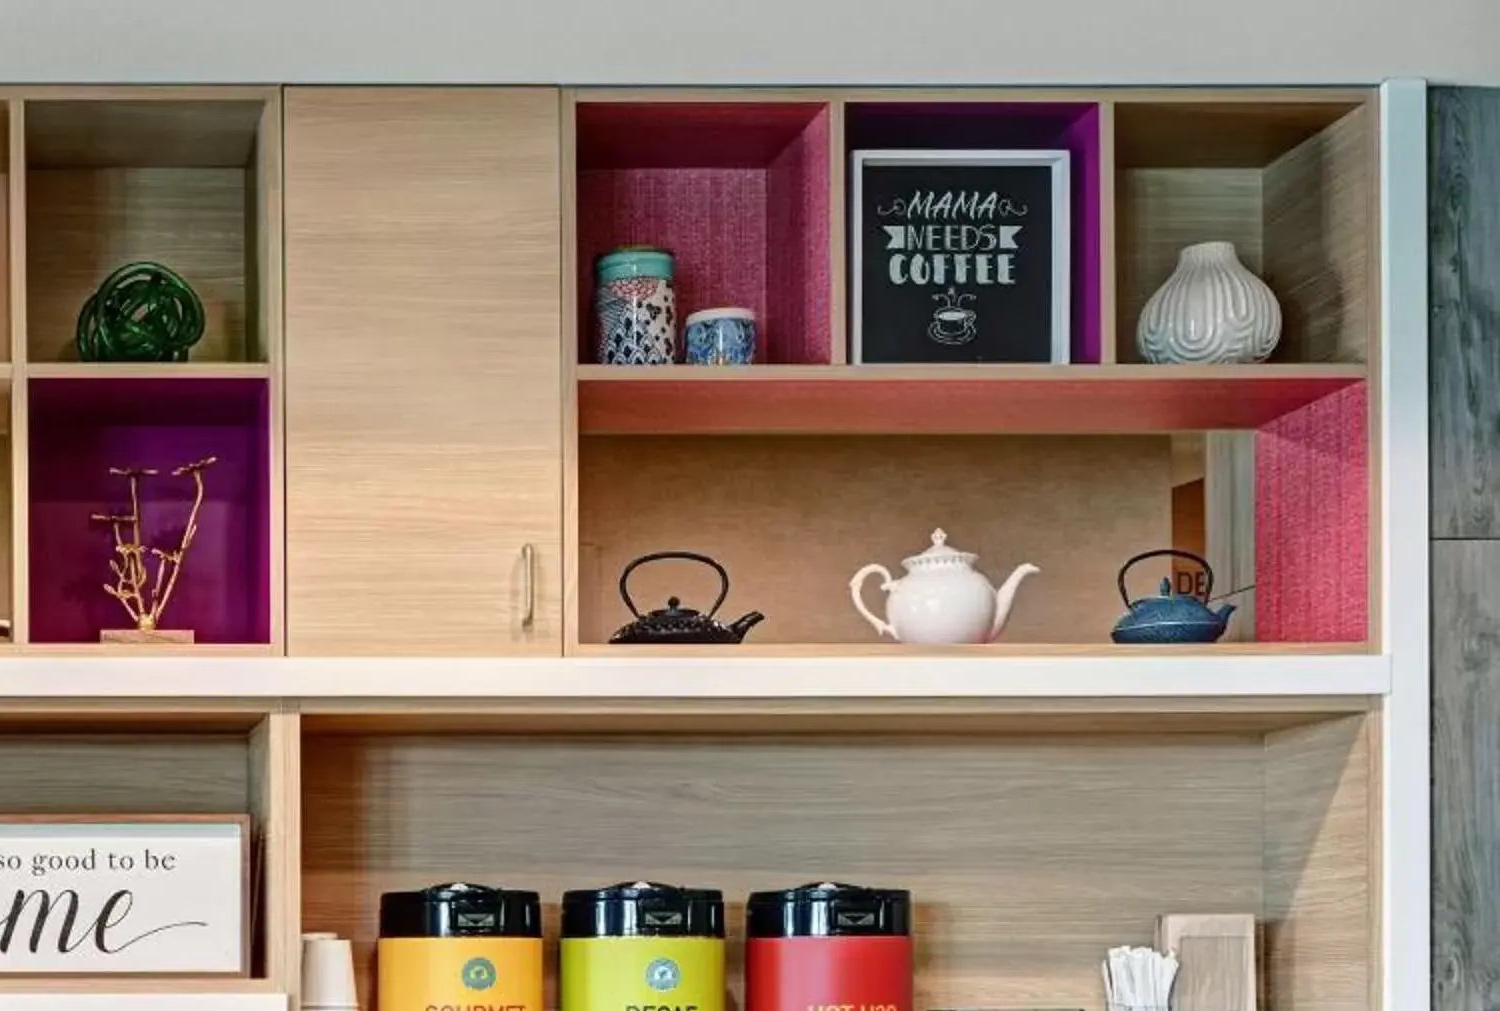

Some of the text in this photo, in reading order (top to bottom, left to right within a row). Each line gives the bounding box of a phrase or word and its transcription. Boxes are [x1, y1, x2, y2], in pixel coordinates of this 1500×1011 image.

[906, 190, 999, 220] MAMA
[906, 224, 998, 251] NEEDS
[888, 253, 1016, 285] COFFEE
[31, 848, 96, 877] good
[108, 850, 135, 872] to
[145, 848, 177, 872] be
